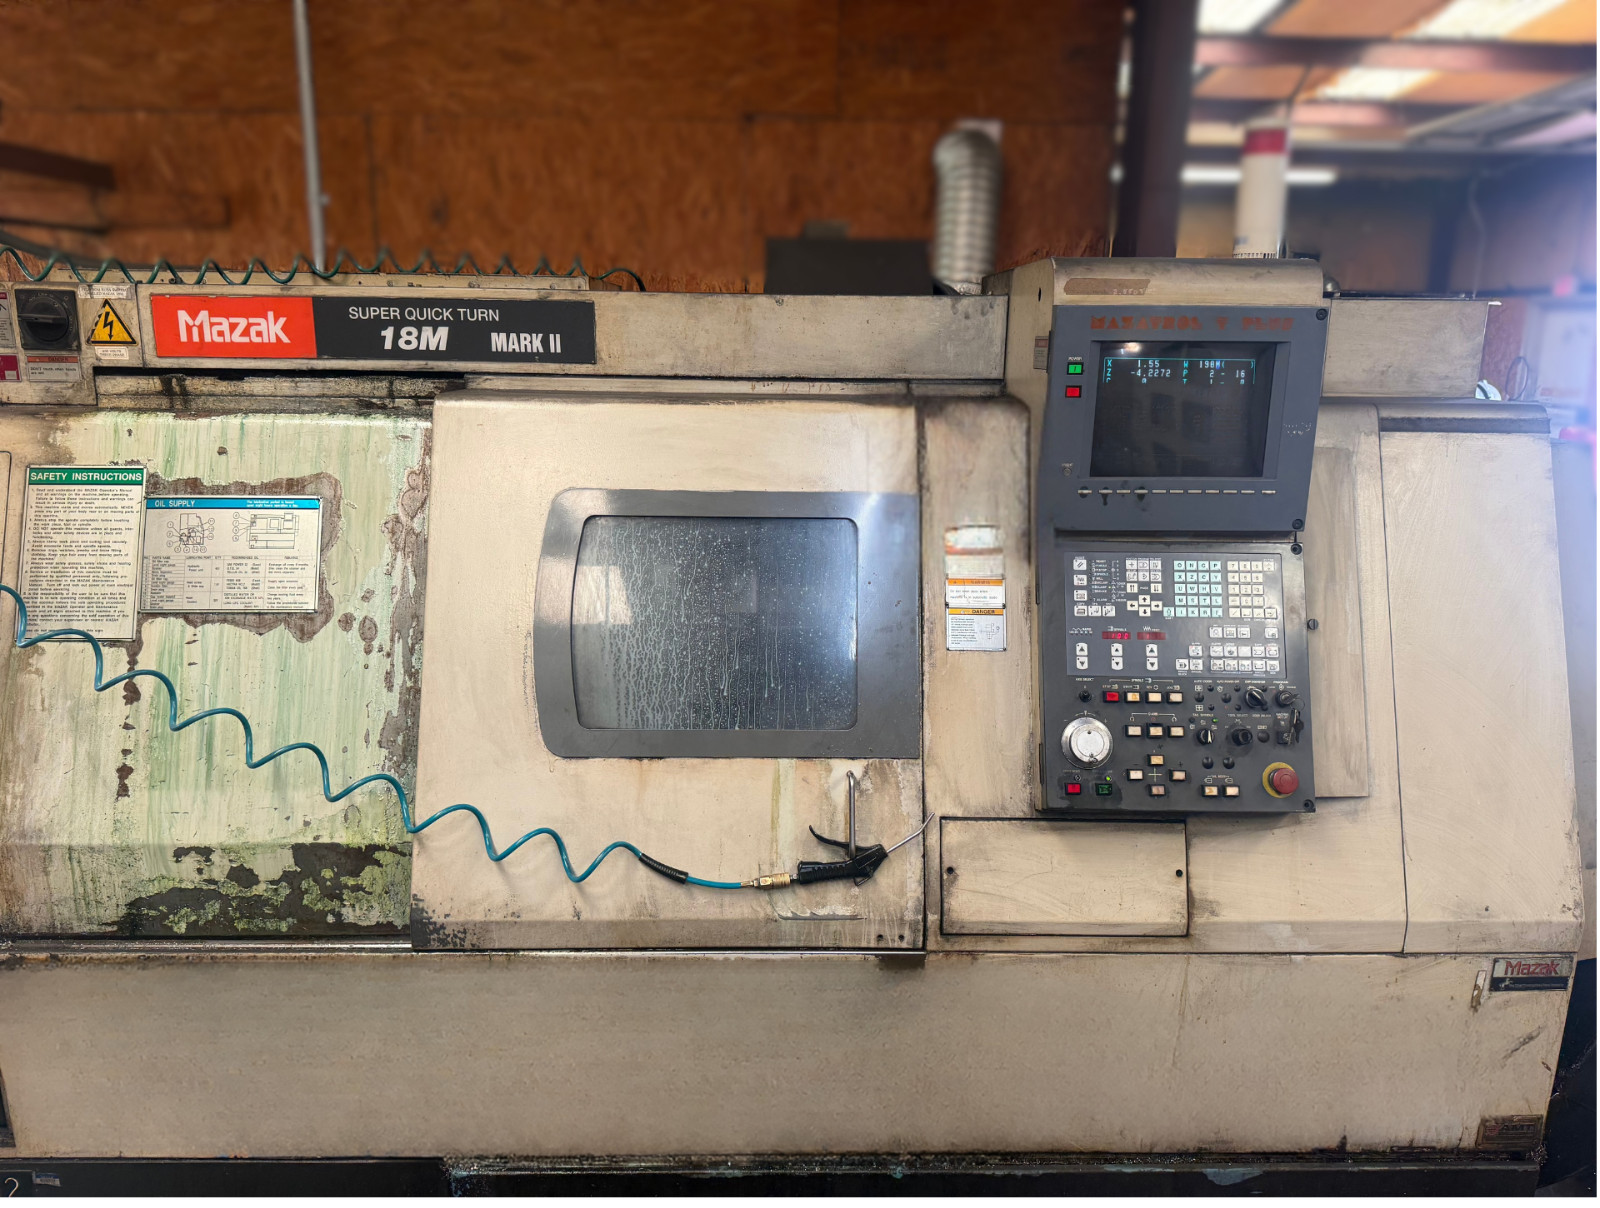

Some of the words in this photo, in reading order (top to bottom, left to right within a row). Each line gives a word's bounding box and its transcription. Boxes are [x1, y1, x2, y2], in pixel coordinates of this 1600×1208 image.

[348, 306, 400, 320] SUPER
[404, 308, 455, 322] QUICK
[458, 309, 499, 322] TURN
[178, 310, 291, 344] Mazak
[380, 326, 448, 351] 18M
[490, 332, 543, 353] MARK
[548, 334, 561, 354] II
[1106, 368, 1112, 376] Z
[1131, 369, 1171, 377] -4.2272
[1210, 370, 1215, 378] 2
[1236, 369, 1245, 378] 16
[1504, 961, 1560, 975] Mazak
